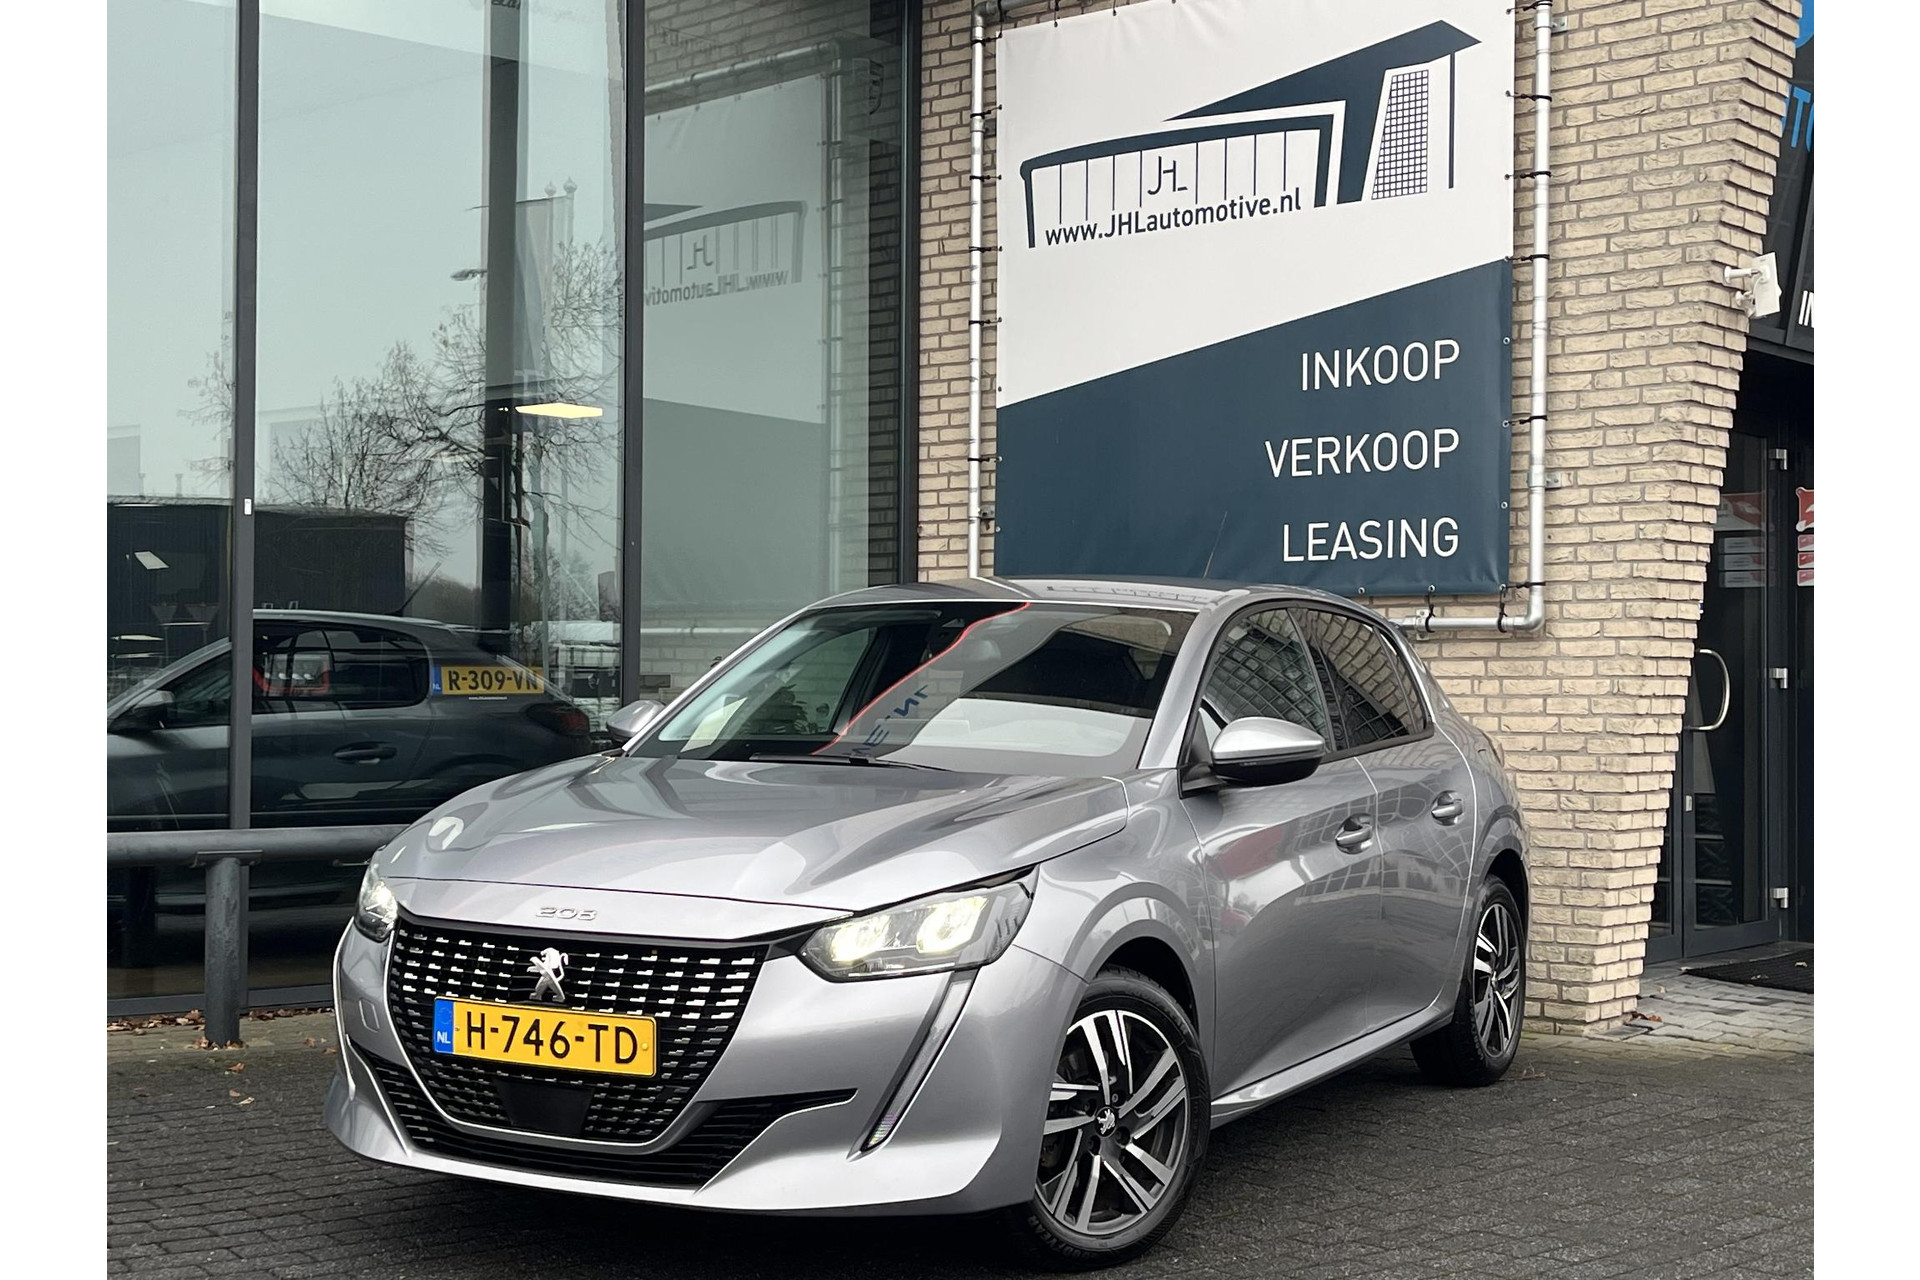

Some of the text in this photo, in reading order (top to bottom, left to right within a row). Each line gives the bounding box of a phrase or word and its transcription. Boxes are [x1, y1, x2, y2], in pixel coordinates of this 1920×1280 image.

[1147, 155, 1187, 196] JHL
[1045, 187, 1302, 246] www.JHLautomotive.nl
[1301, 339, 1460, 391] INKOOP
[1264, 428, 1460, 478] VERKOOP
[1283, 517, 1459, 562] LEASING
[448, 669, 539, 692] R-309-VN
[436, 1030, 452, 1045] NL
[466, 1011, 638, 1065] H-746-TD
